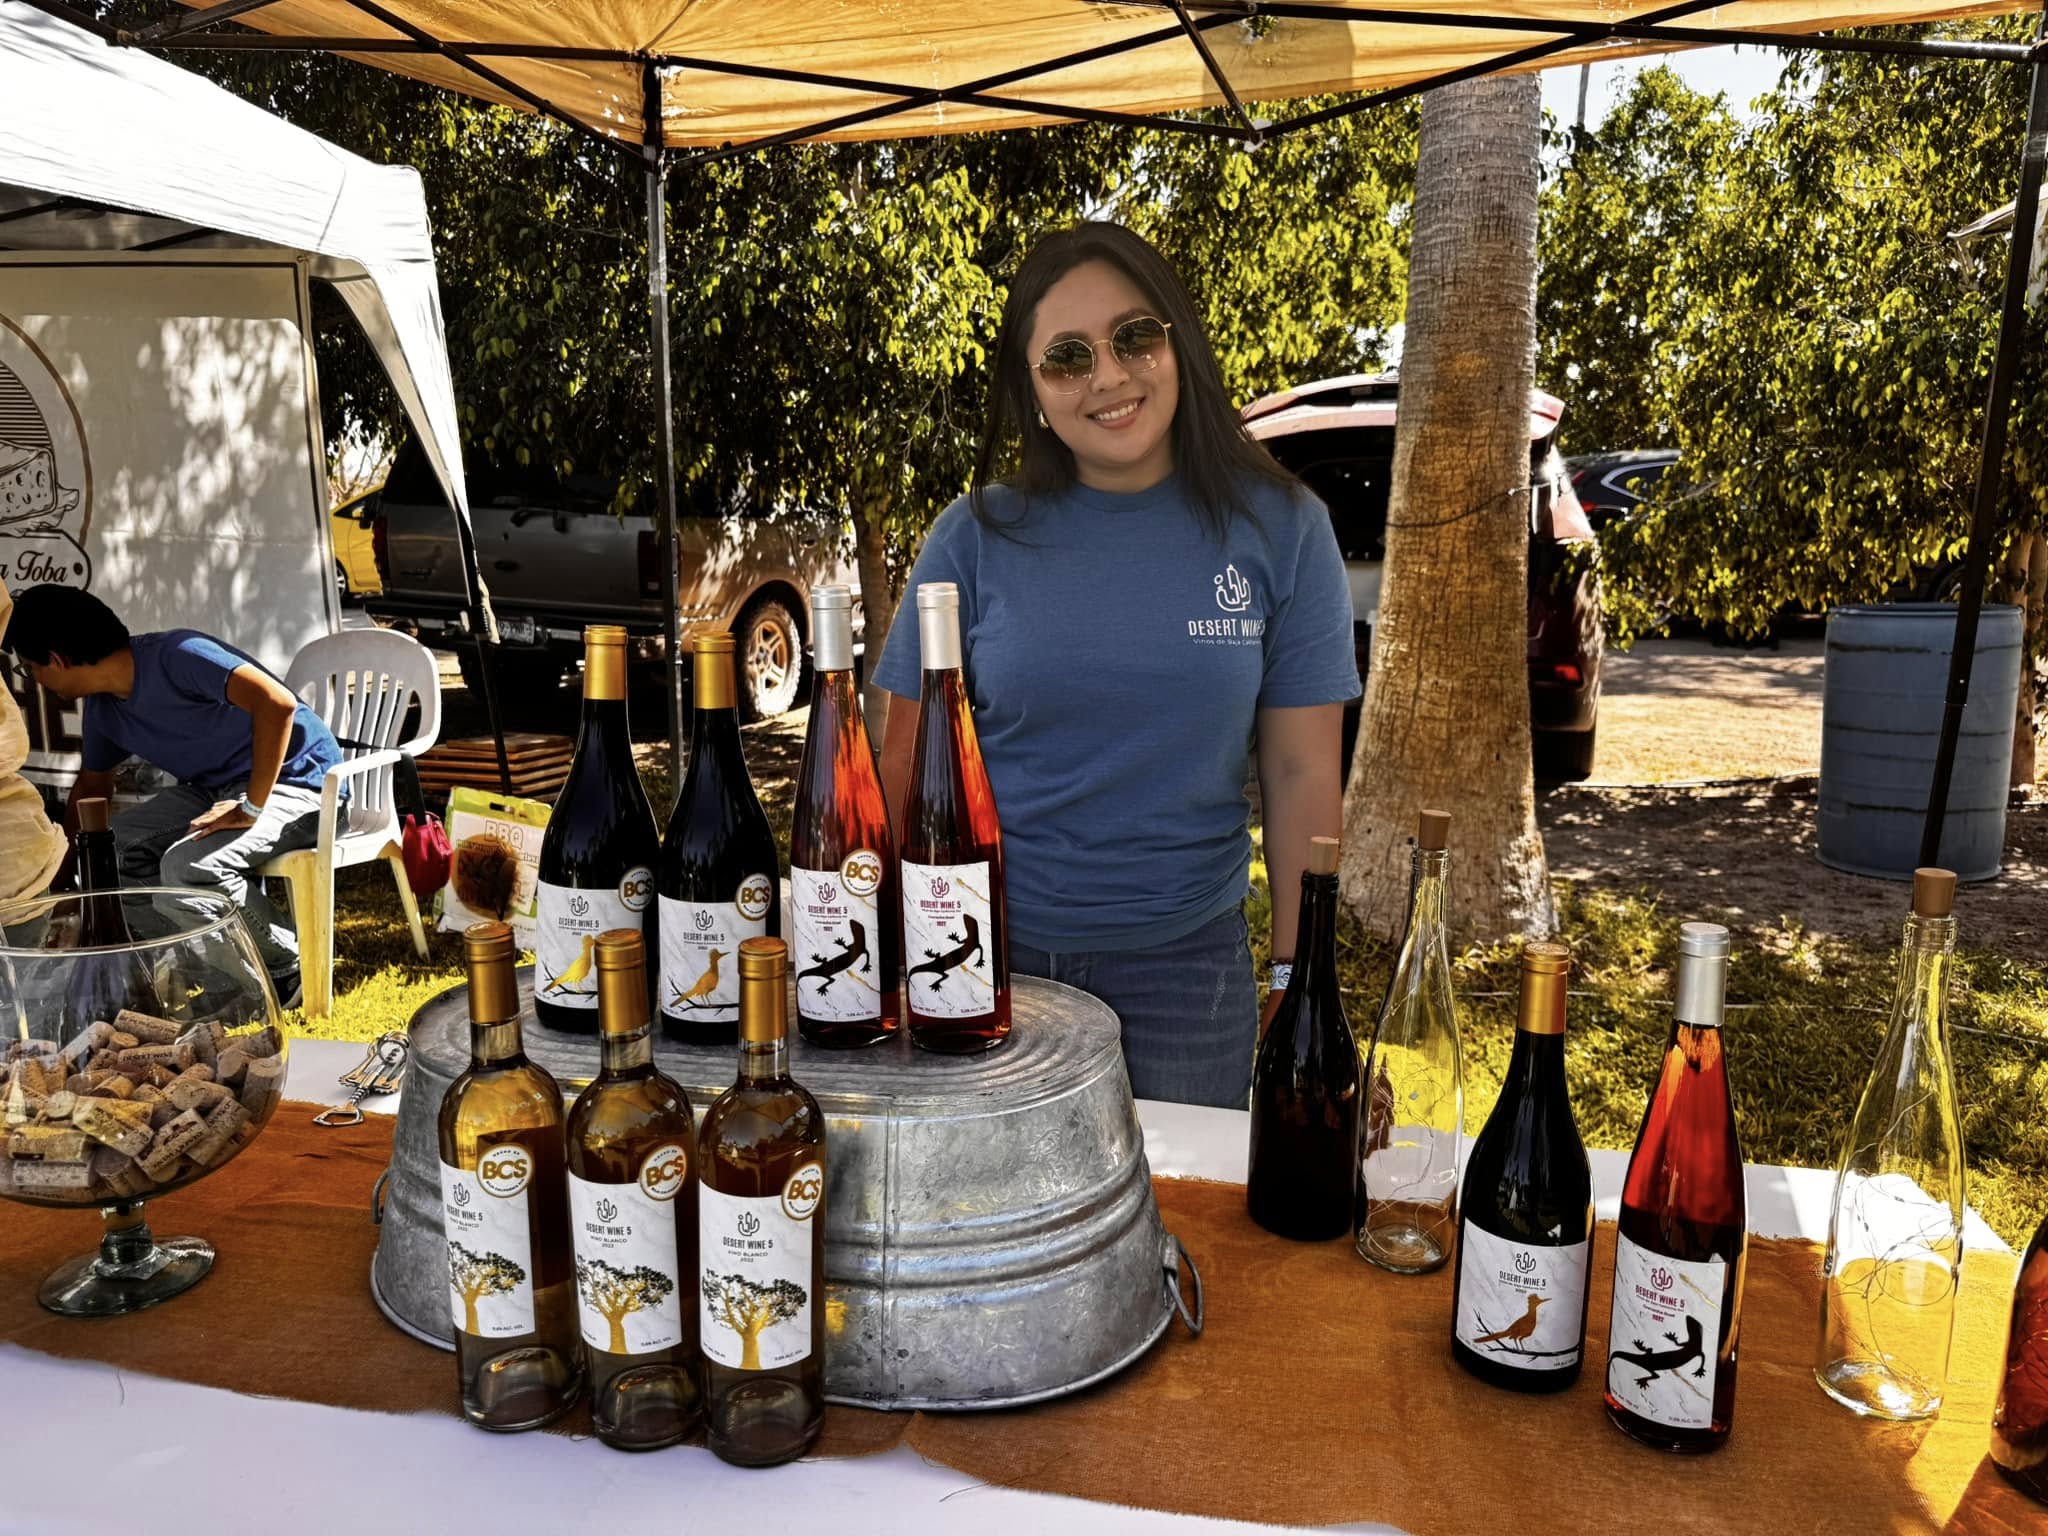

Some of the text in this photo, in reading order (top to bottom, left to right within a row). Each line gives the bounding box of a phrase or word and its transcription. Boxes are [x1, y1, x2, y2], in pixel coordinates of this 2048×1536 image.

[15, 550, 67, 582] Toba
[1188, 618, 1236, 636] DESERT
[484, 820, 524, 849] BBQ
[845, 861, 880, 883] BCS
[624, 878, 652, 898] BCS
[741, 886, 770, 904] BCS
[483, 1159, 528, 1179] BCS
[645, 1155, 684, 1188] BCS
[787, 1178, 820, 1201] BCS
[585, 1222, 605, 1235] DESERT
[607, 1226, 624, 1236] WINE
[723, 1236, 745, 1249] DESERT
[747, 1240, 765, 1249] WINE
[1499, 1270, 1521, 1283] DESERT
[1524, 1277, 1540, 1286] WINE
[1635, 1284, 1657, 1301] DESERT
[1659, 1295, 1677, 1307] WINE
